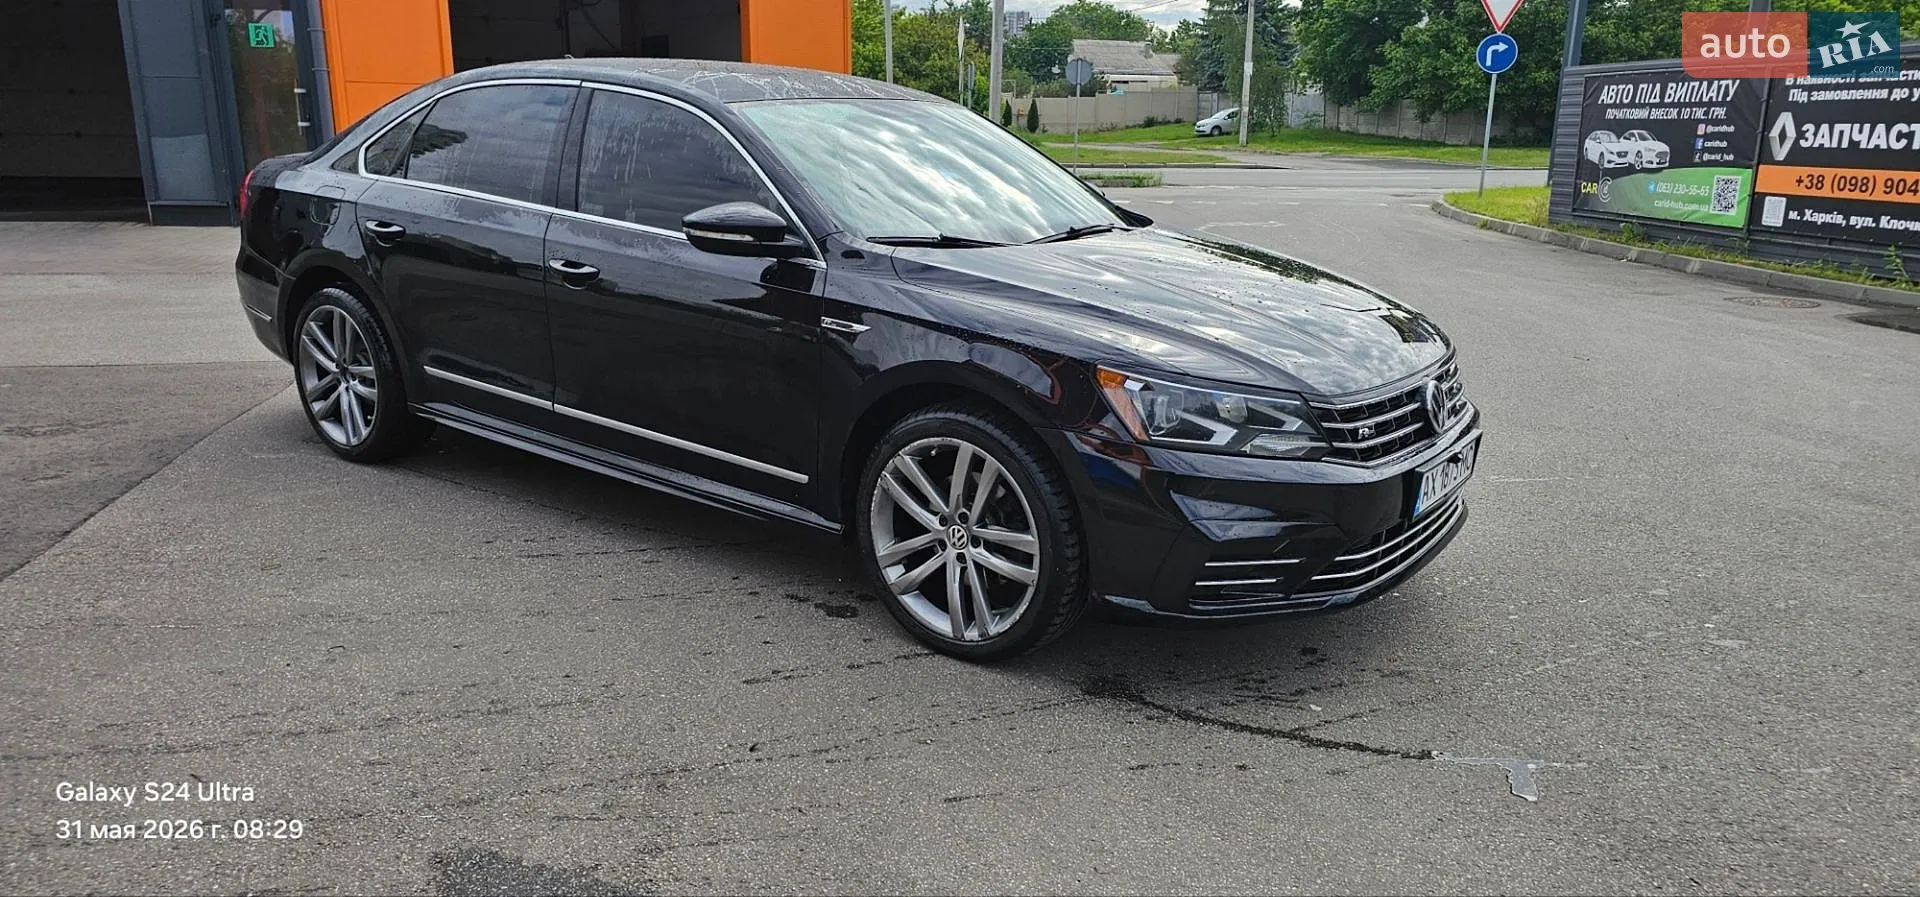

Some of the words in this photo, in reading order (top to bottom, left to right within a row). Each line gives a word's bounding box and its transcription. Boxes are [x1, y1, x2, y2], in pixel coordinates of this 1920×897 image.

[1598, 84, 1633, 104] АВТО
[1635, 82, 1660, 103] ПІД
[1664, 79, 1740, 103] ВИПЛАТУ
[1788, 88, 1808, 103] Під
[1810, 88, 1888, 101] замовлення
[1890, 87, 1909, 101] до
[1605, 106, 1649, 119] ПОЧАТКОВИЙ
[1650, 108, 1679, 119] ВНЕСОК
[1680, 107, 1691, 119] 10
[1708, 107, 1727, 119] ГРН.
[1581, 181, 1598, 195] CAR
[1795, 173, 1825, 190] +38
[1830, 172, 1876, 197] (098)
[1883, 177, 1920, 197] 904
[1788, 210, 1800, 220] м.
[1803, 208, 1846, 227] Харків,
[1849, 214, 1876, 228] вул.
